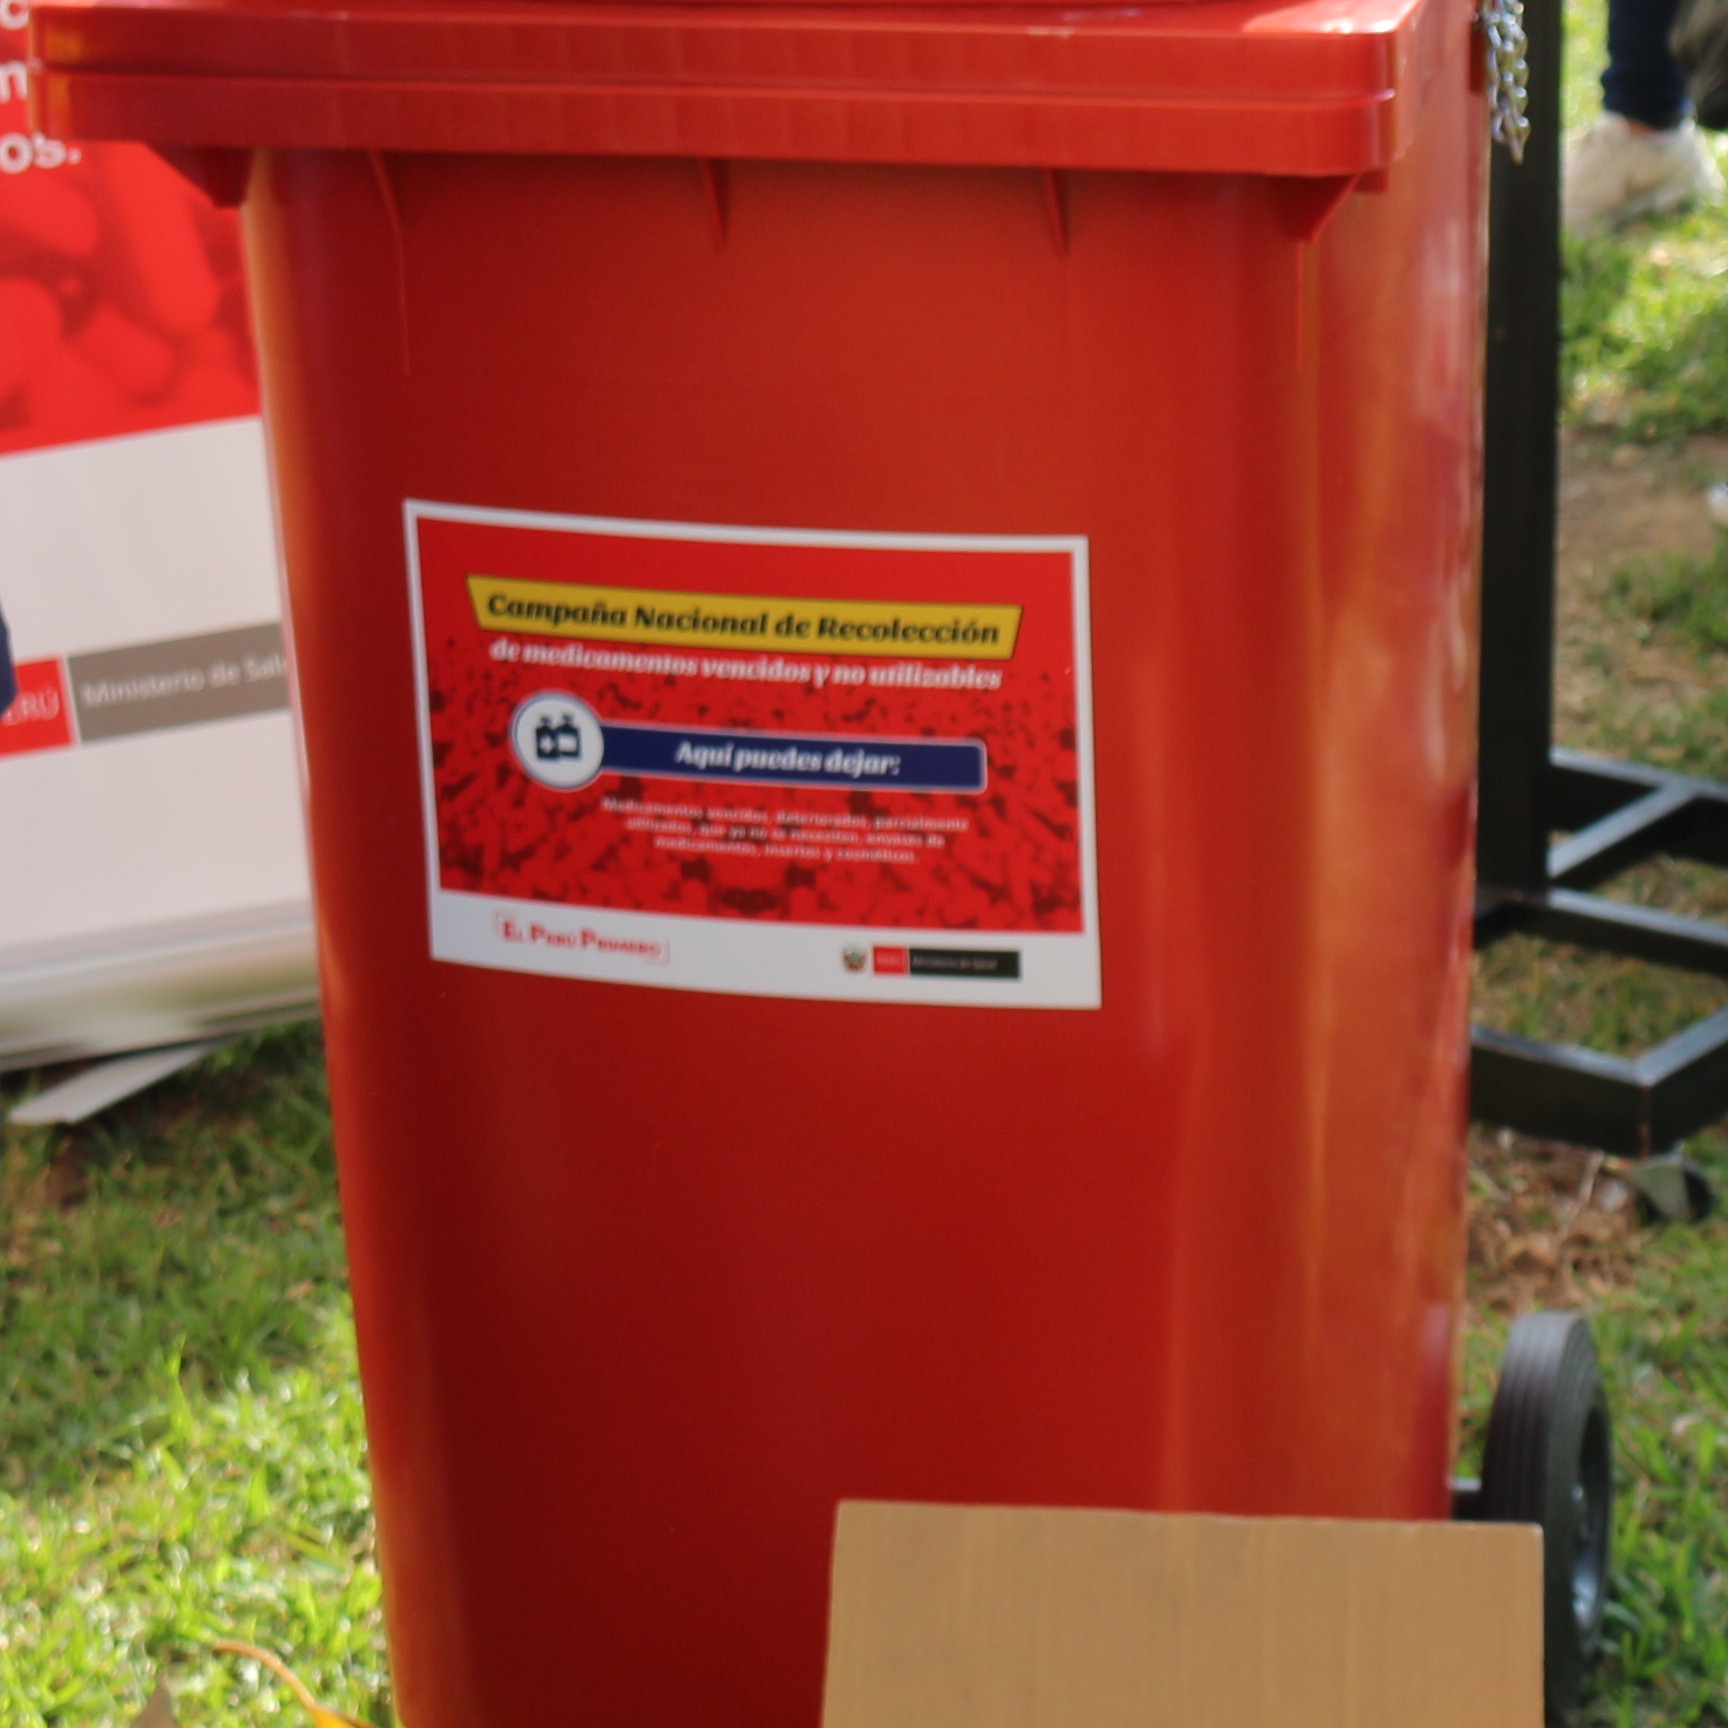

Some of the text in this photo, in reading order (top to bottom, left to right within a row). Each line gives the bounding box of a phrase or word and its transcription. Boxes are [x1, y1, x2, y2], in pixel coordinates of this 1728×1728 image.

[488, 593, 1001, 645] Campaña Nacional de Recolección
[81, 668, 206, 708] Ministerio
[206, 660, 241, 689] de
[242, 651, 286, 683] Sal
[489, 637, 1004, 690] de medicamentos vencidos y no utilizables
[674, 740, 902, 779] Aquí puedes dejar:
